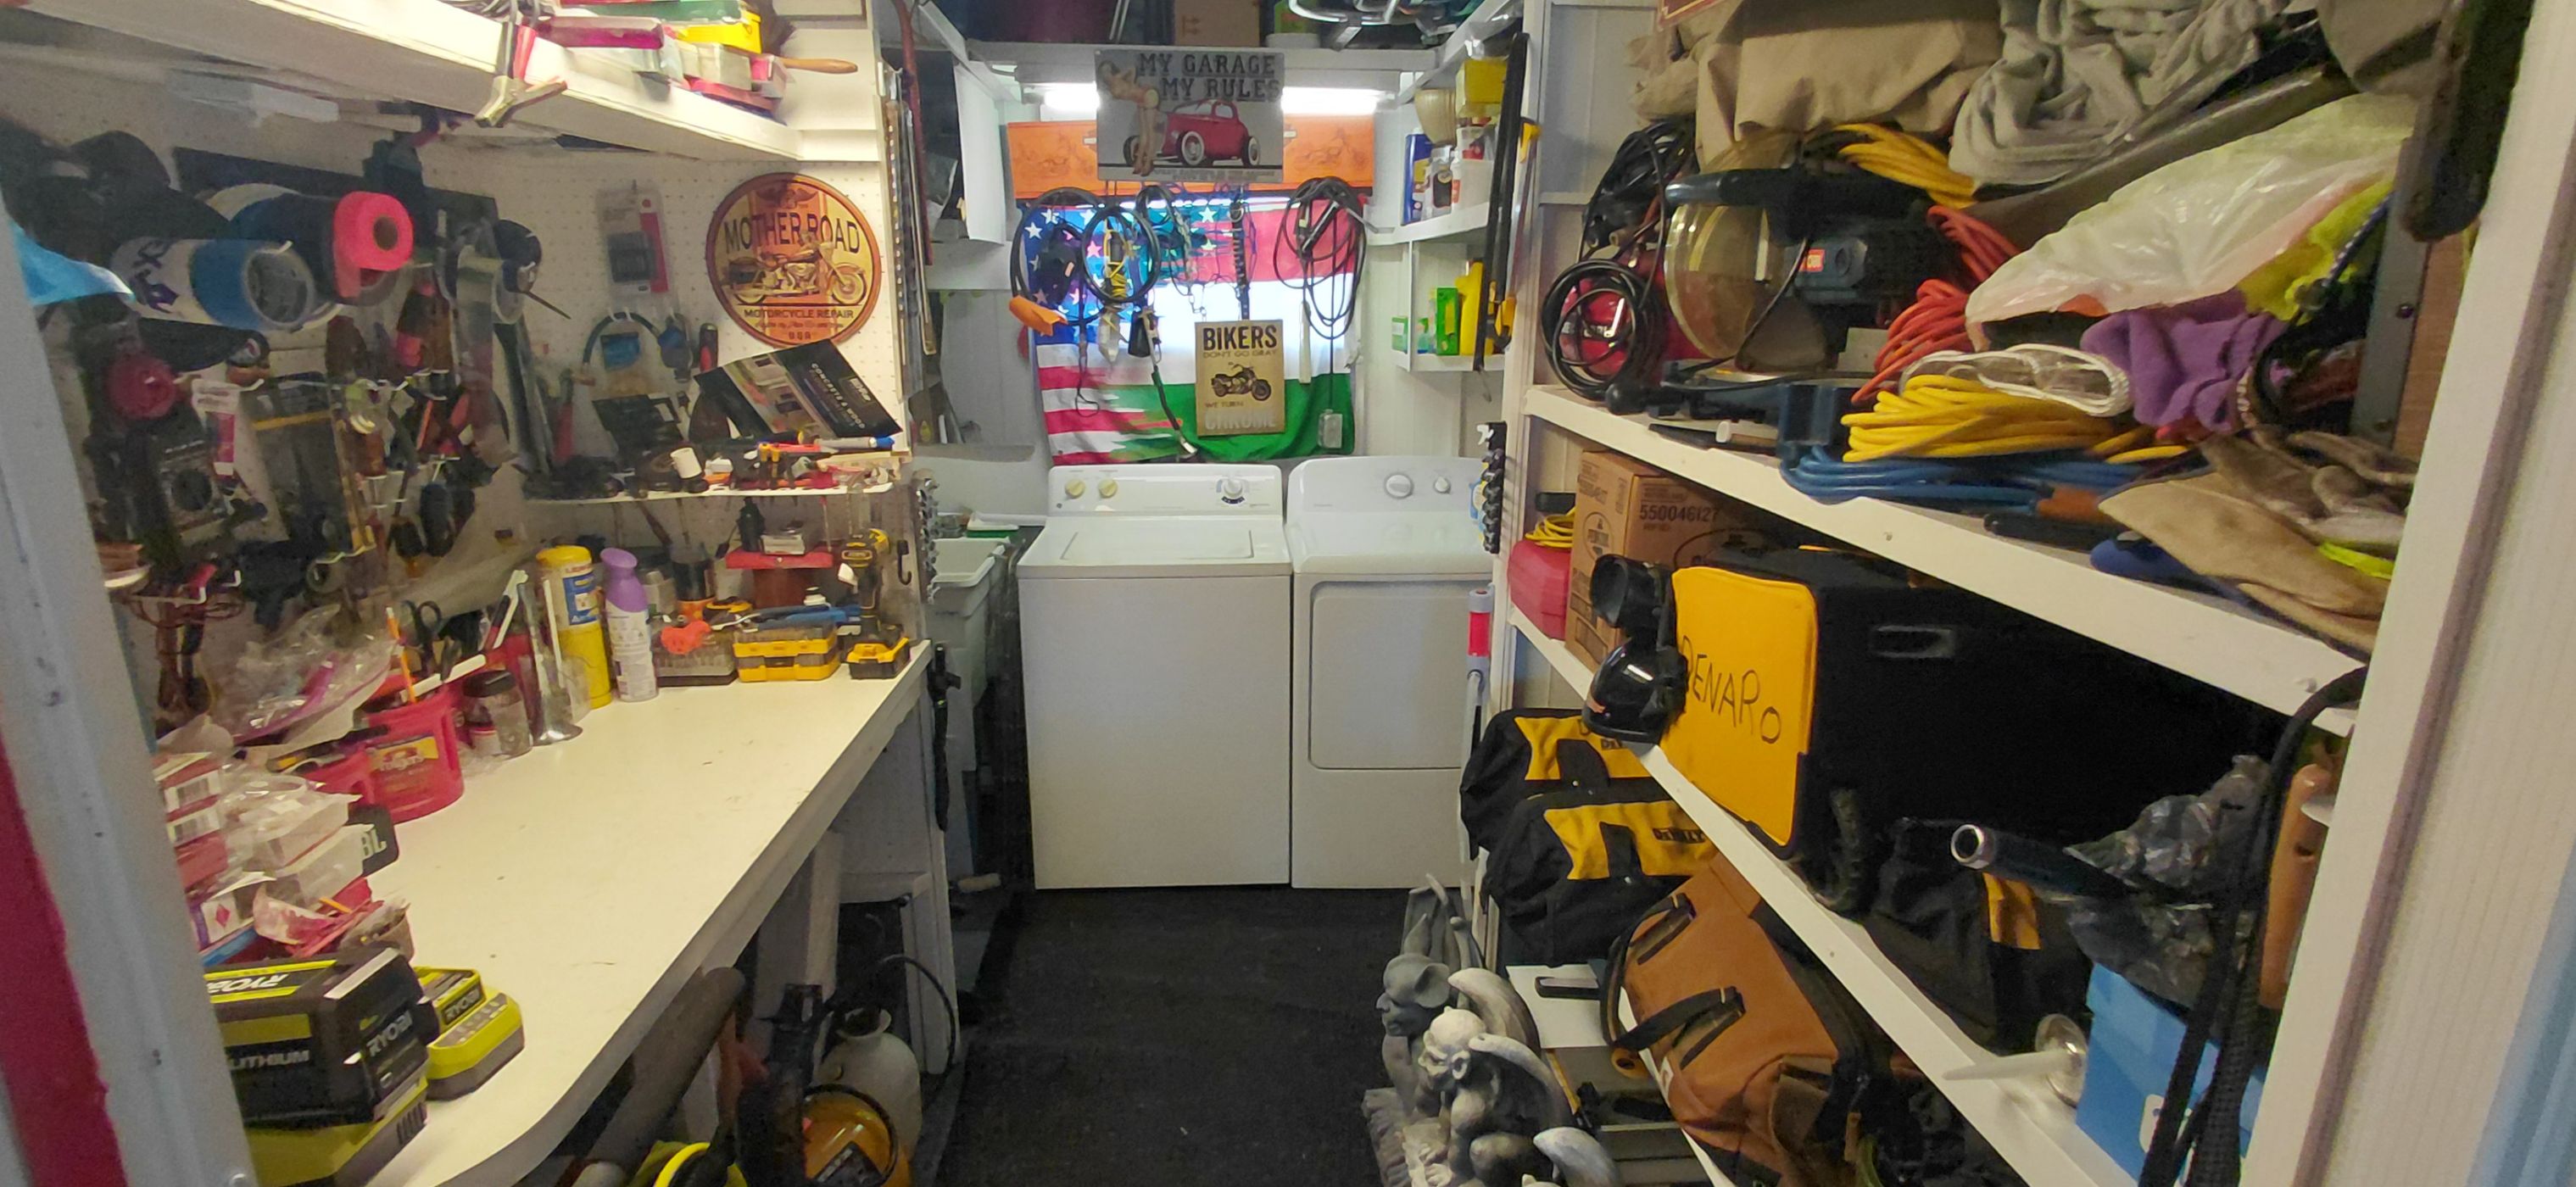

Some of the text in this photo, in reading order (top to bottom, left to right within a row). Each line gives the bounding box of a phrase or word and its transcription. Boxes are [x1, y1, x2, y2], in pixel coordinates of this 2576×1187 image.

[1139, 53, 1275, 76] MY GARAGE
[1161, 78, 1280, 101] MY RULES
[724, 213, 861, 254] MOTHER ROAD
[744, 309, 855, 319] MOTORCYCLE REPAIR
[1202, 325, 1277, 351] BIKERS
[811, 363, 844, 401] CONCRETE
[846, 408, 866, 429] WOOD
[361, 828, 387, 860] BL
[206, 973, 289, 994] RYOB
[444, 987, 481, 1023] RYOBI
[365, 1010, 414, 1057] RYOBI
